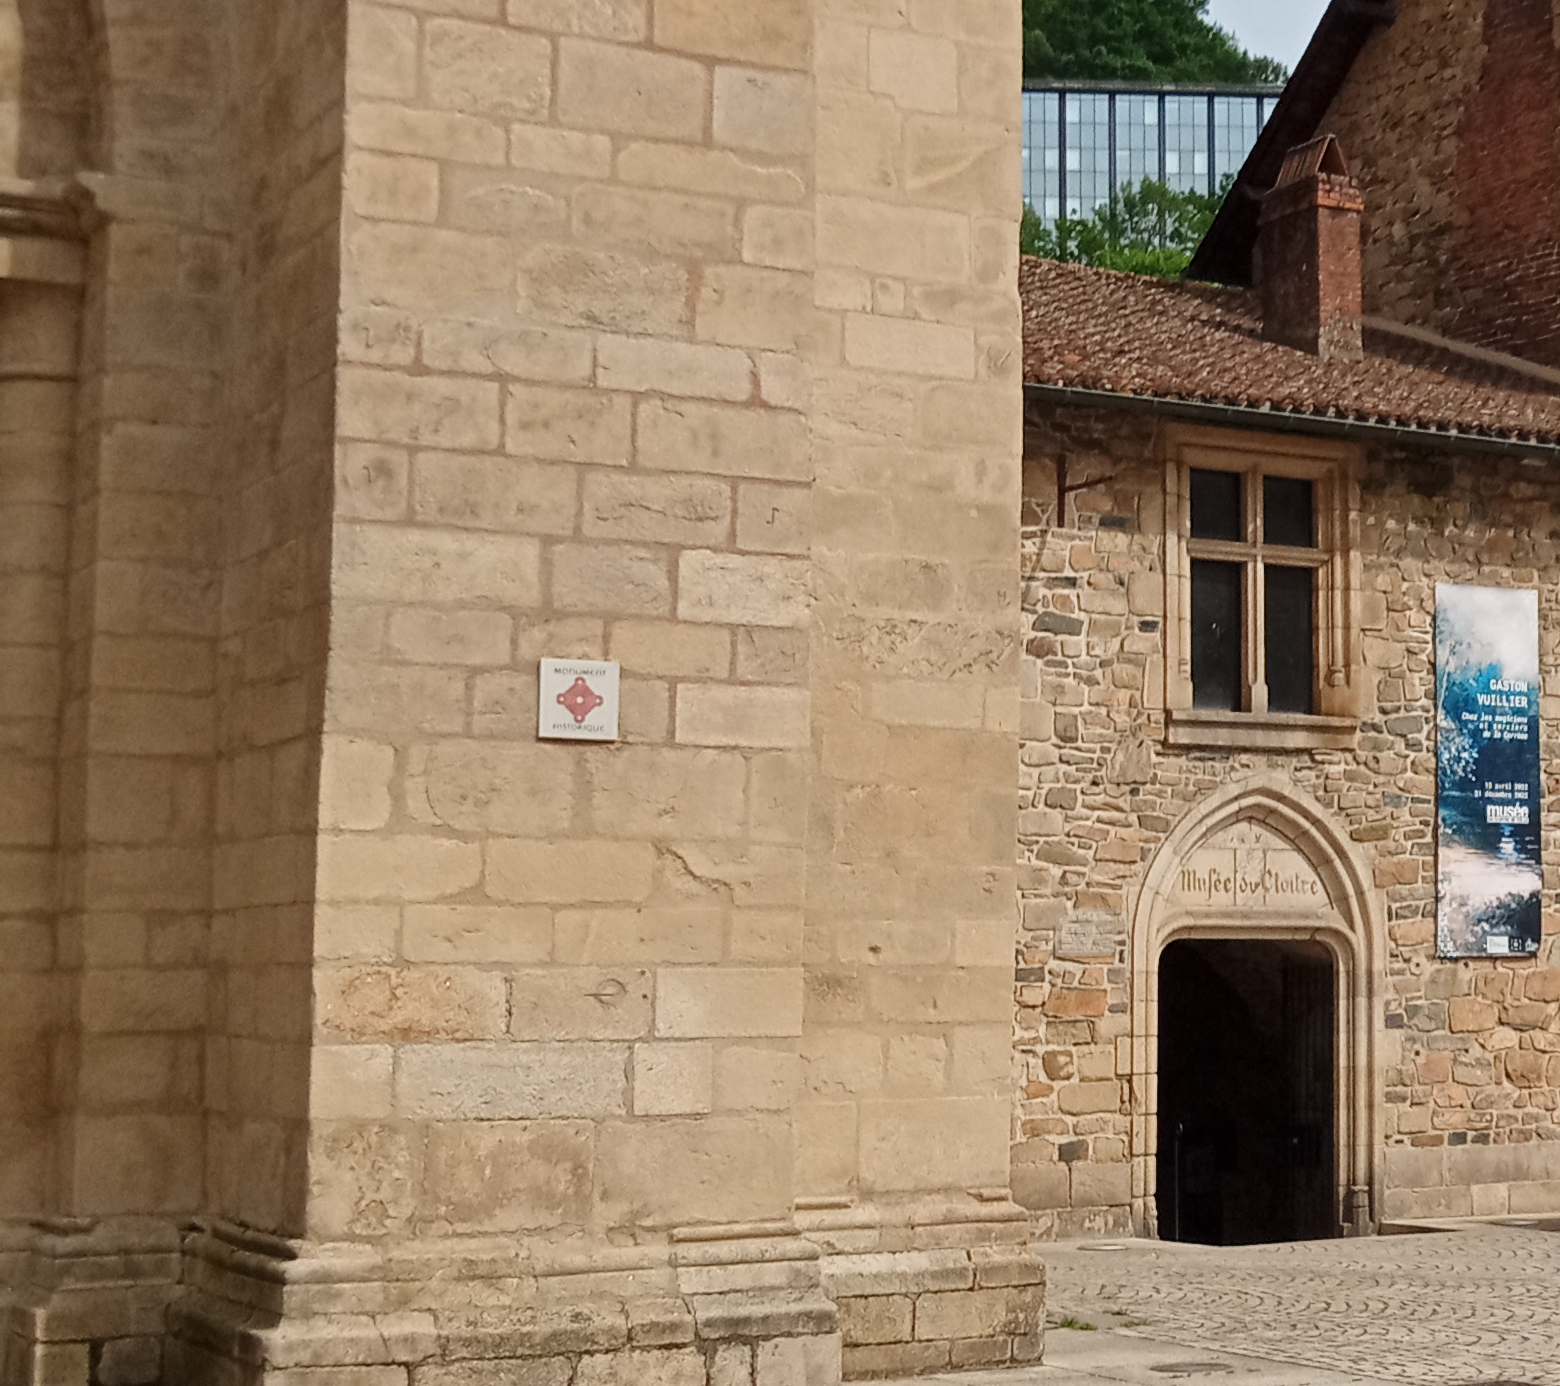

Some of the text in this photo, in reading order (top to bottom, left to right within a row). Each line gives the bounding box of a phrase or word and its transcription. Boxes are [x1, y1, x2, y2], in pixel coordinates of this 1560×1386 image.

[554, 668, 606, 676] MONUMENT
[1490, 679, 1528, 692] GASTON
[1477, 693, 1528, 707] VUILLIER
[552, 723, 605, 732] HISTORIQUE
[1487, 801, 1529, 817] musée
